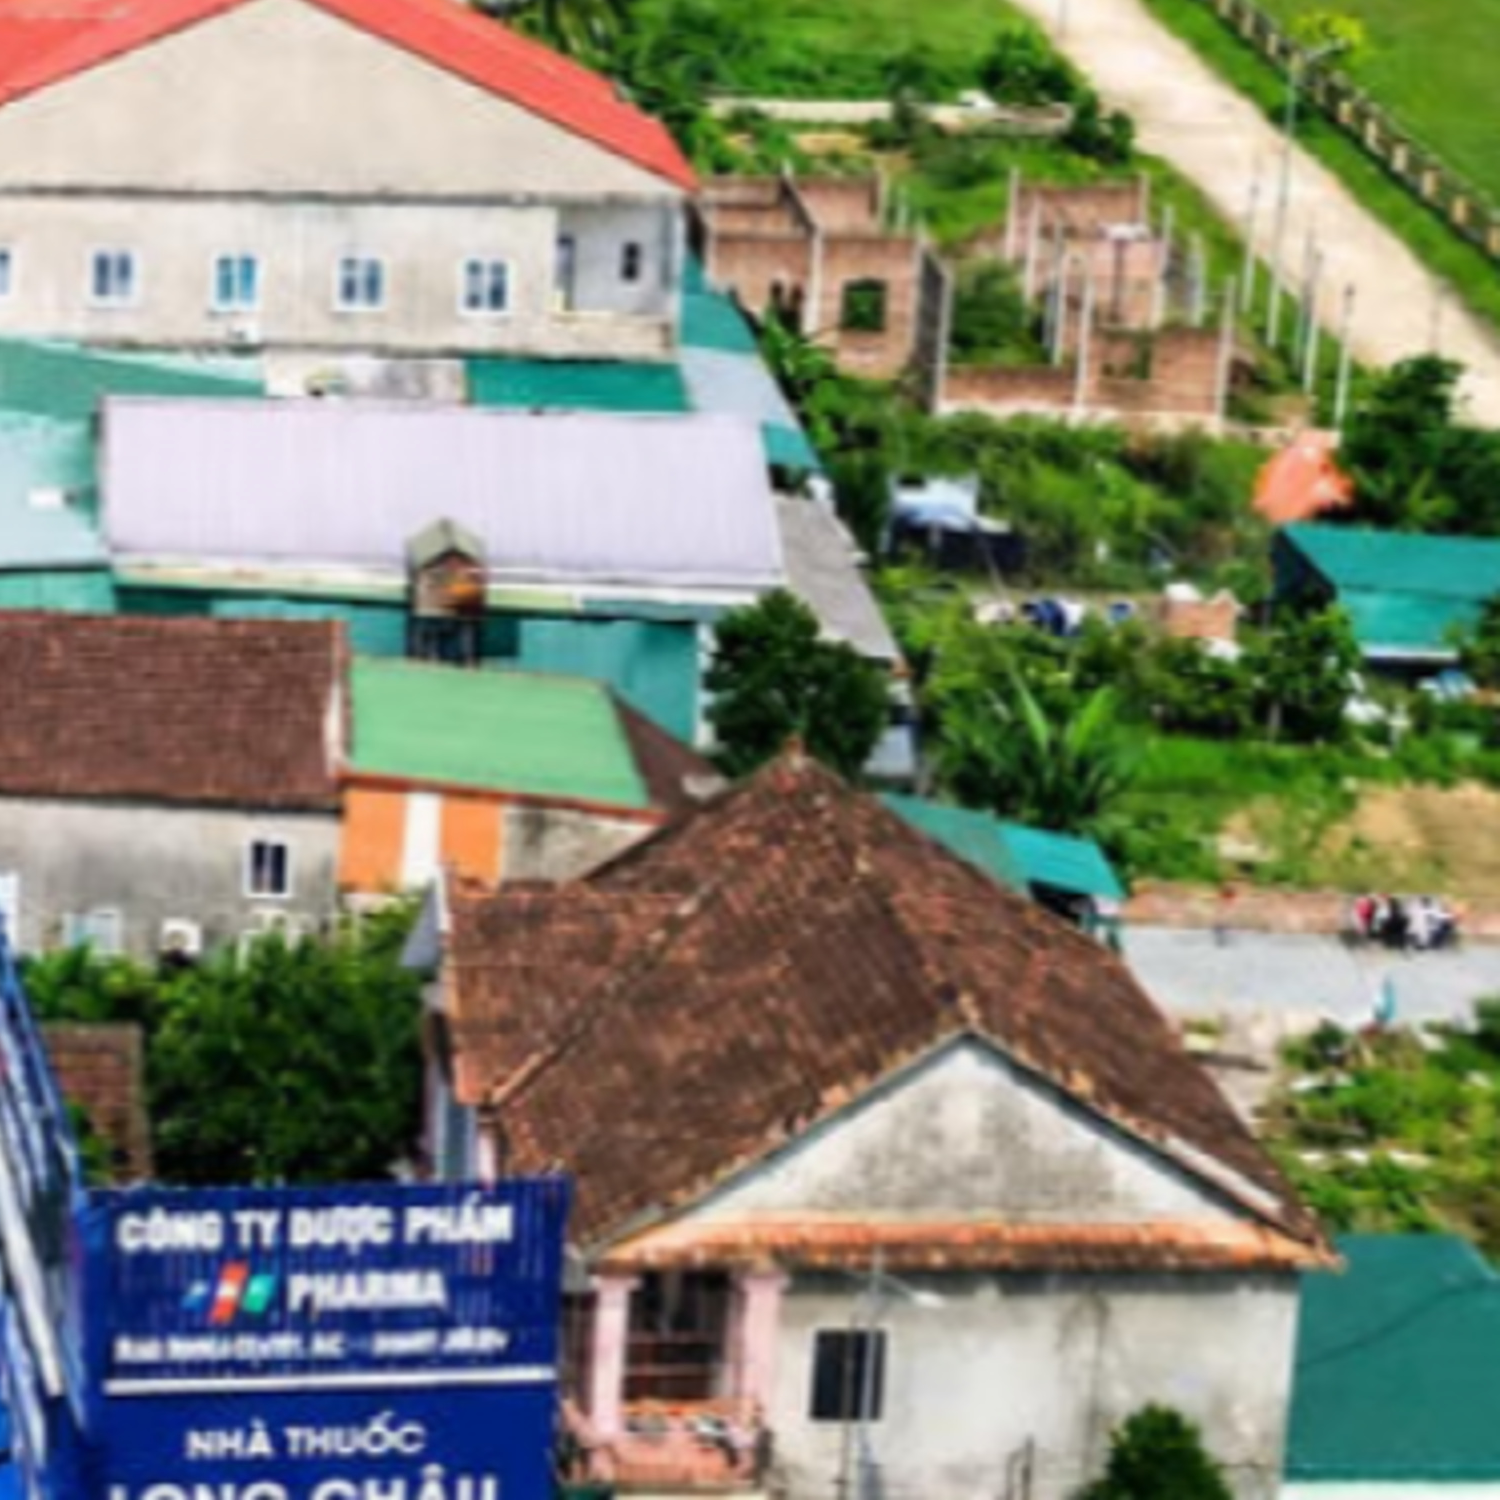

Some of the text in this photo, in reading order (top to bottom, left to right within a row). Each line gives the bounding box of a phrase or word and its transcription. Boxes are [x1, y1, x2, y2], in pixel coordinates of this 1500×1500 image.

[116, 1205, 222, 1251] CÔNG
[232, 1209, 281, 1249] TY
[185, 1410, 426, 1459] NHÀ THUỐC
